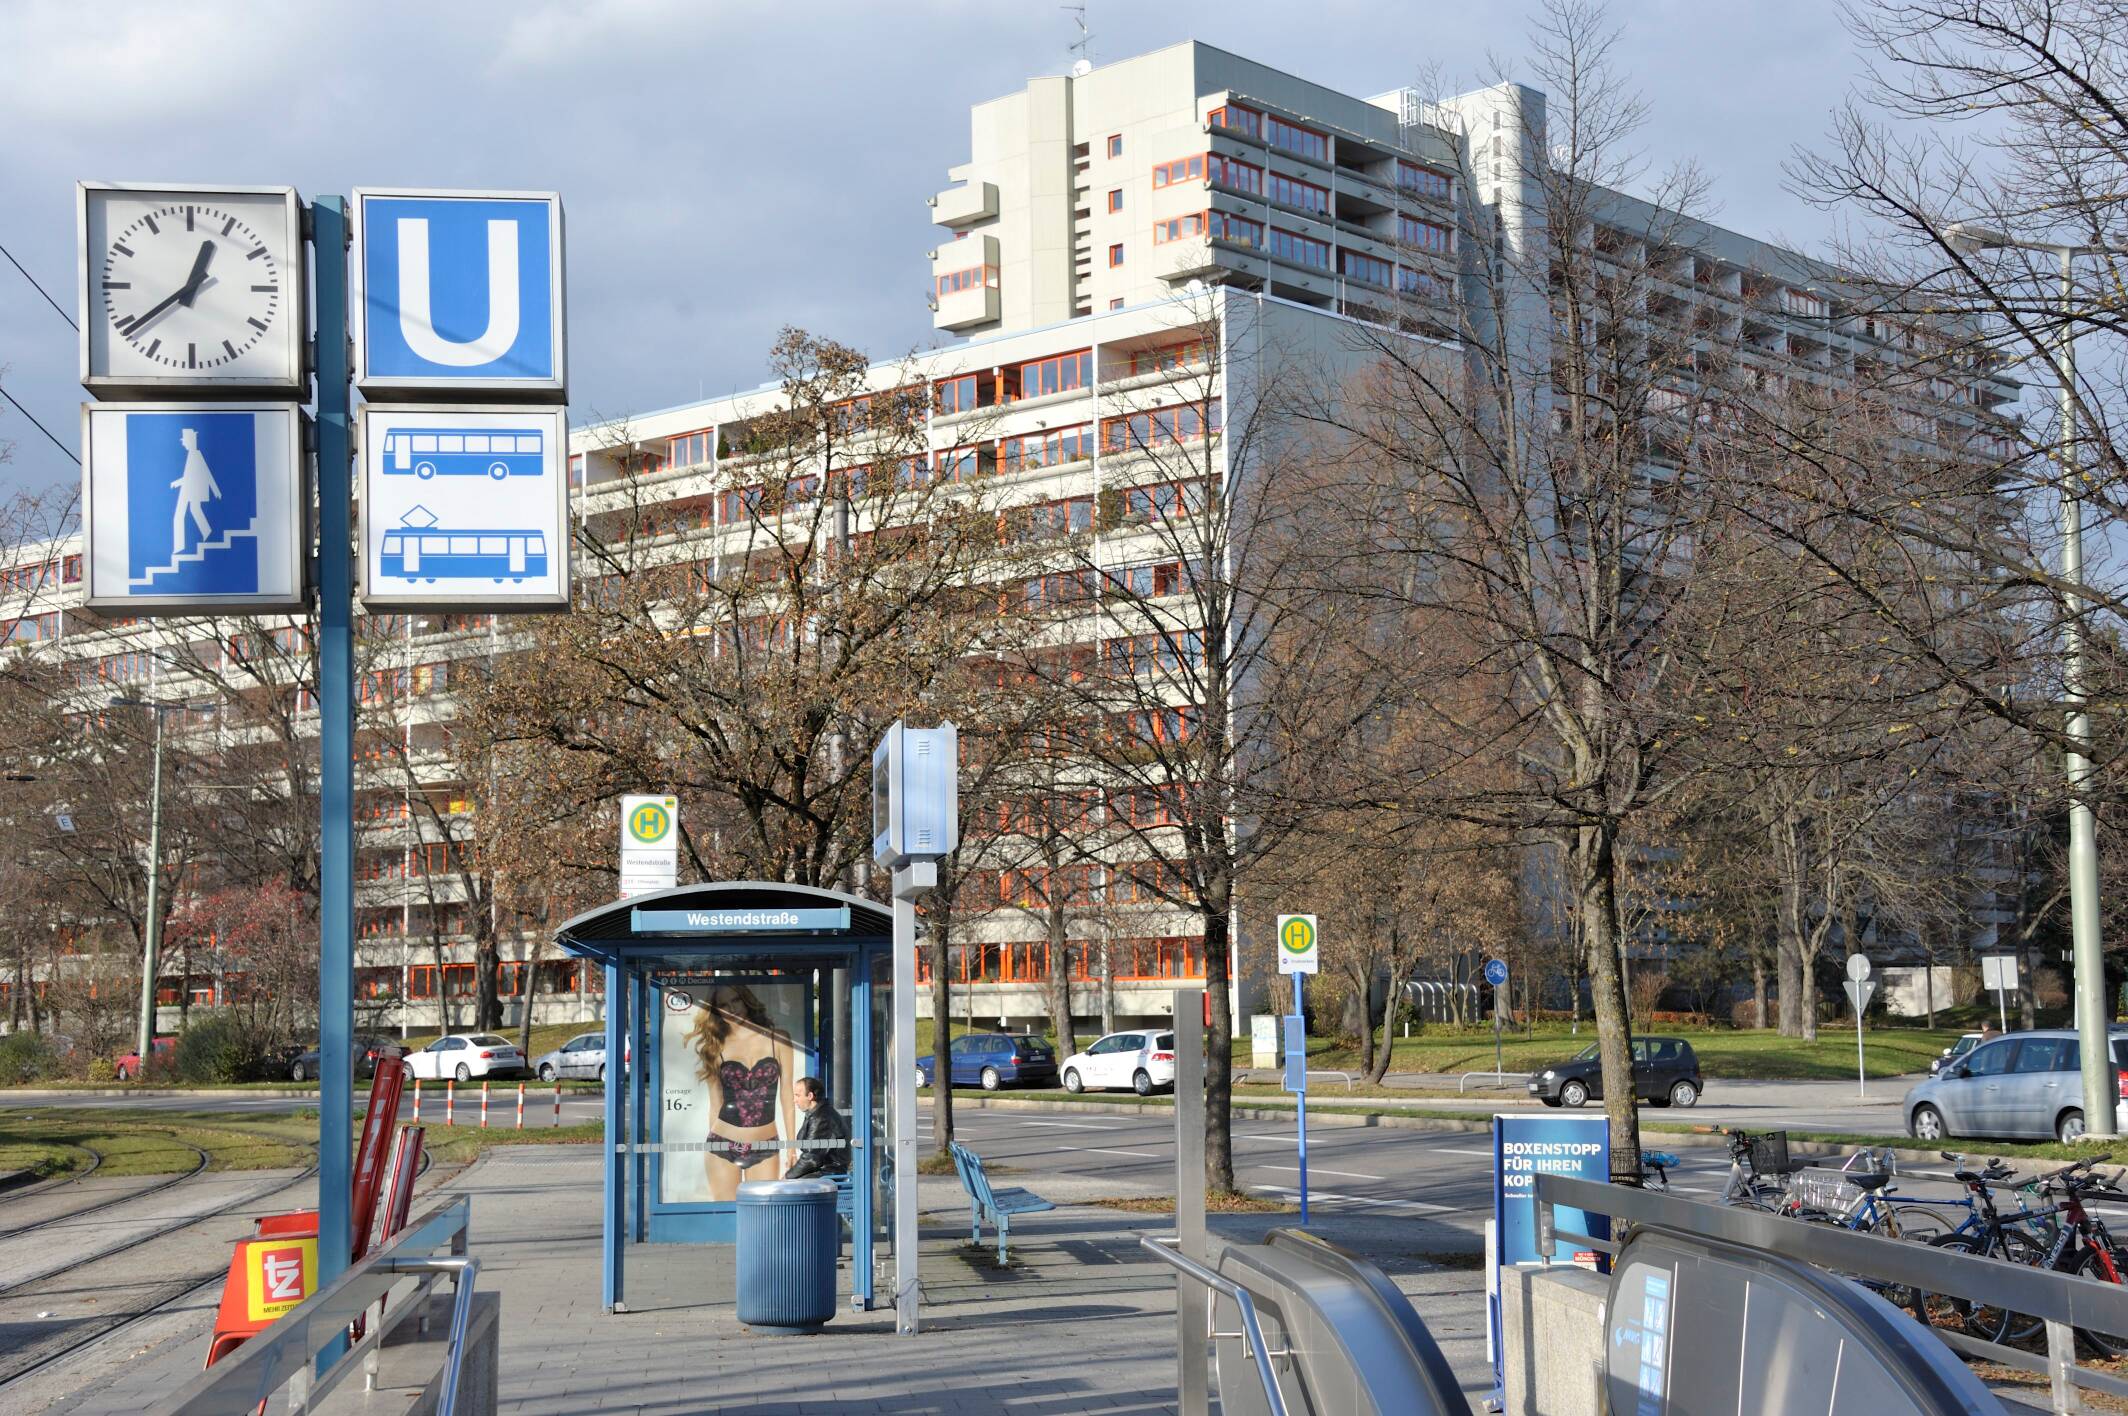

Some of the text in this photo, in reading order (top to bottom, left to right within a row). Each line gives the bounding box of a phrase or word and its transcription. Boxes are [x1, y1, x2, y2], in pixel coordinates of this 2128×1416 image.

[397, 218, 519, 367] U
[640, 811, 659, 833] H
[687, 911, 799, 926] Westendstraße
[1290, 924, 1305, 946] H
[667, 1098, 693, 1111] 16.-
[1503, 1142, 1602, 1156] BOXENSTOPP
[1504, 1156, 1582, 1172] FÜR IHREN
[1504, 1175, 1534, 1187] KOP
[264, 1255, 300, 1298] tz
